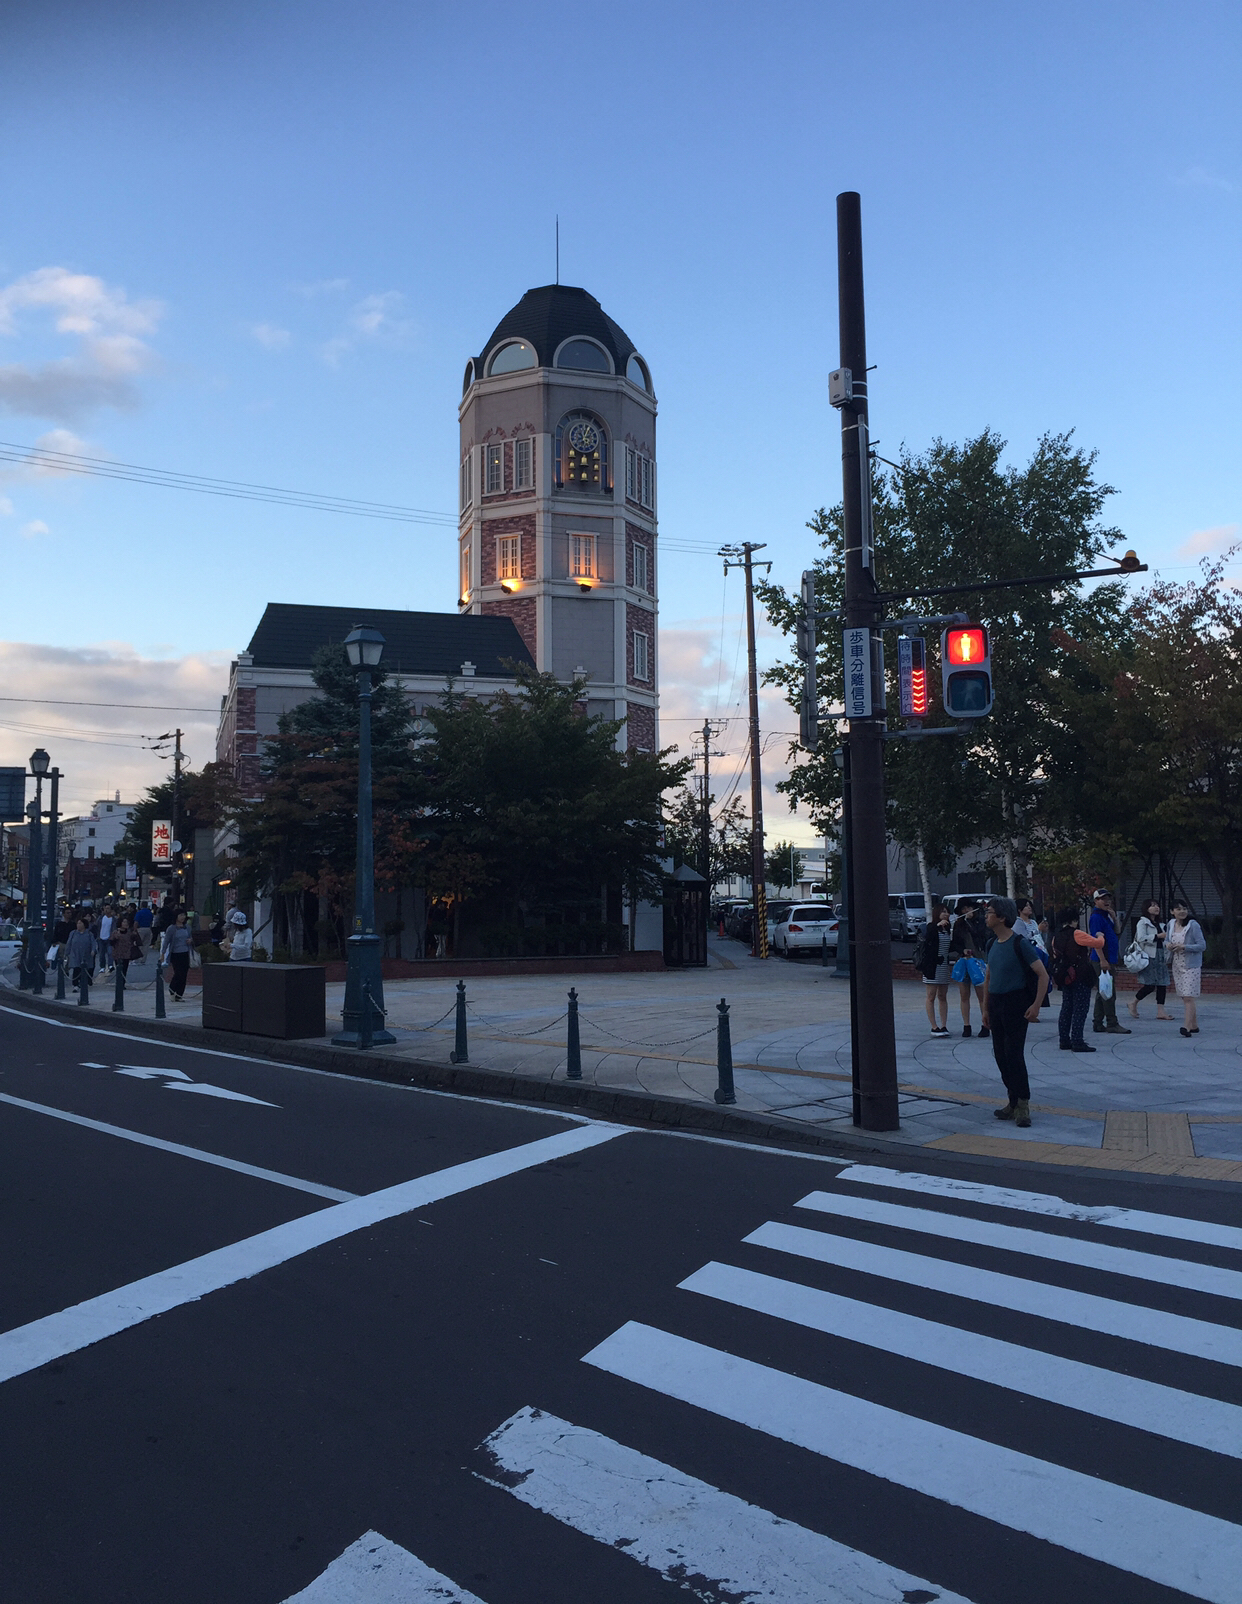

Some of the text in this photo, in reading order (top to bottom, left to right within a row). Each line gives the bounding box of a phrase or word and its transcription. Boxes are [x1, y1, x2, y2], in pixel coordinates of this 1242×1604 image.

[849, 631, 865, 715] 歩車分離信号
[900, 641, 912, 713] 待時間表示灯
[153, 823, 170, 858] 地酒
